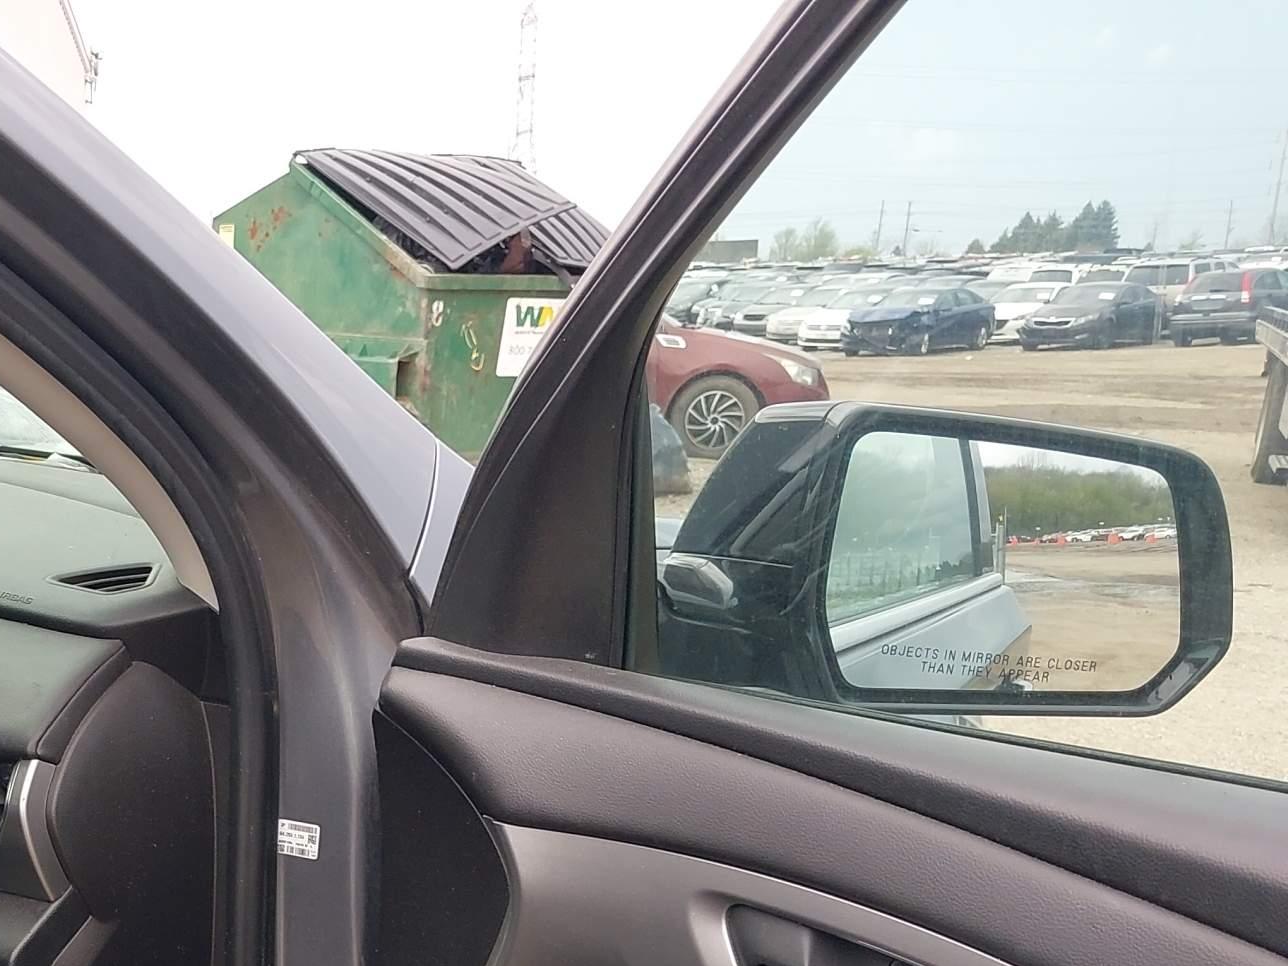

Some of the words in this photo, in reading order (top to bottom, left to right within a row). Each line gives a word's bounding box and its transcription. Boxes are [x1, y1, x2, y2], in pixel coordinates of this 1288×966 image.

[881, 644, 940, 660] OBJECTS
[943, 649, 957, 661] IN
[961, 651, 1010, 666] MIRROR
[1016, 655, 1042, 669] ARE
[1047, 658, 1098, 673] CLOSER
[920, 661, 955, 675] THAN
[961, 664, 992, 679] THEY
[998, 669, 1050, 683] APPEAR
